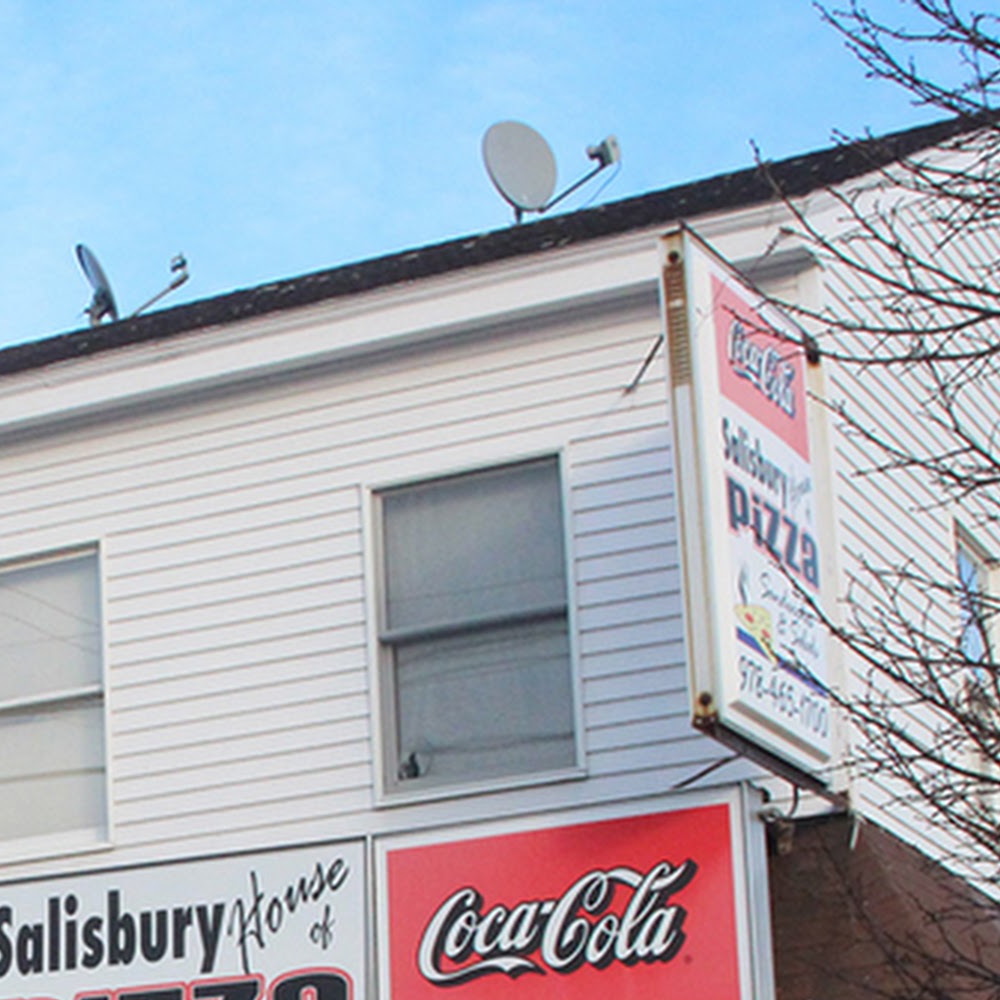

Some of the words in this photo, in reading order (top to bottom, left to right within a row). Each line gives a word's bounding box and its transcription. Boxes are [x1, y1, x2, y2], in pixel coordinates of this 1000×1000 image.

[724, 471, 820, 592] pizza
[227, 858, 349, 975] House
[308, 904, 336, 950] of
[417, 858, 699, 989] Coca-Cola
